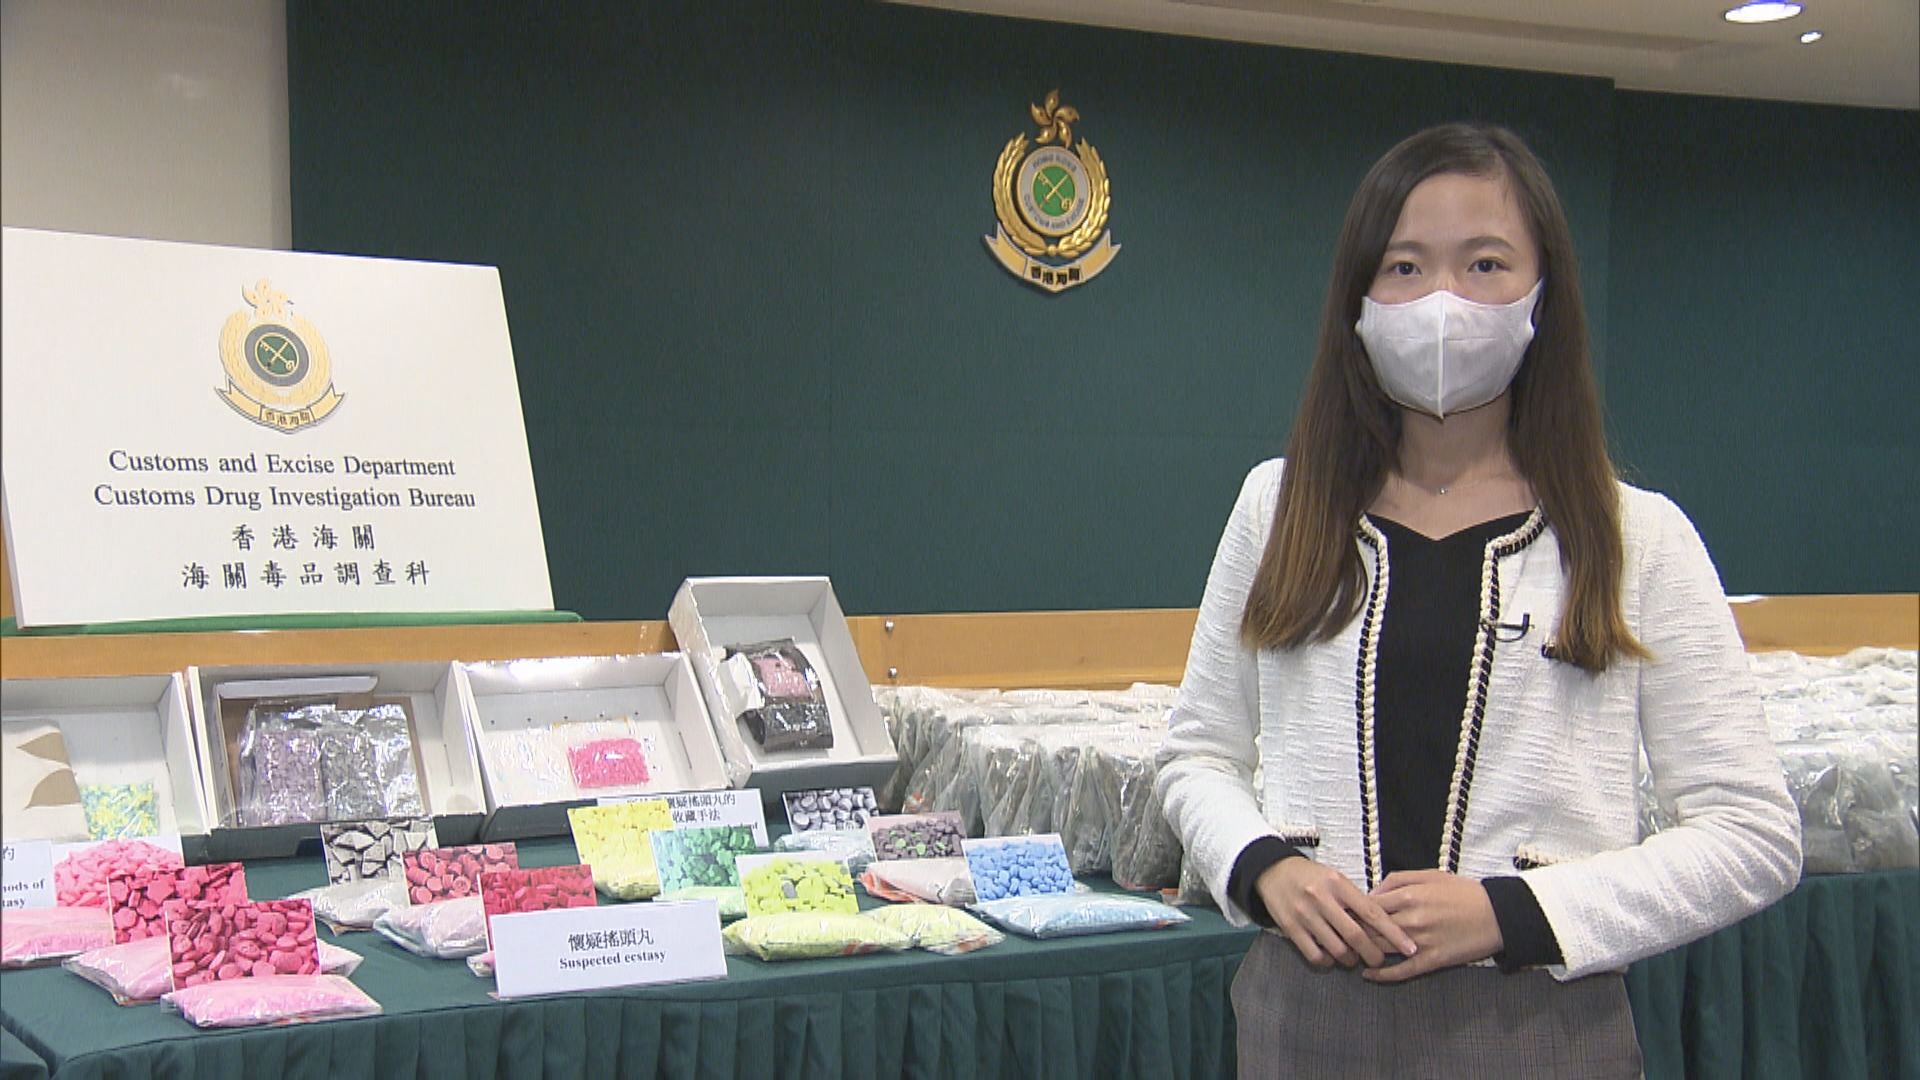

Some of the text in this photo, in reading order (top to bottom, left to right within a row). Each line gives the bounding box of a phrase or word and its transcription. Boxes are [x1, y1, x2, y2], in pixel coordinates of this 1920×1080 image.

[109, 450, 456, 479] Customs and Excise Department
[94, 484, 476, 512] Customs Drug Investigation Bureau
[232, 523, 376, 551] 香港海關
[181, 559, 430, 590] 海關毒品調查科
[560, 950, 666, 970] Suspected ecstasy
